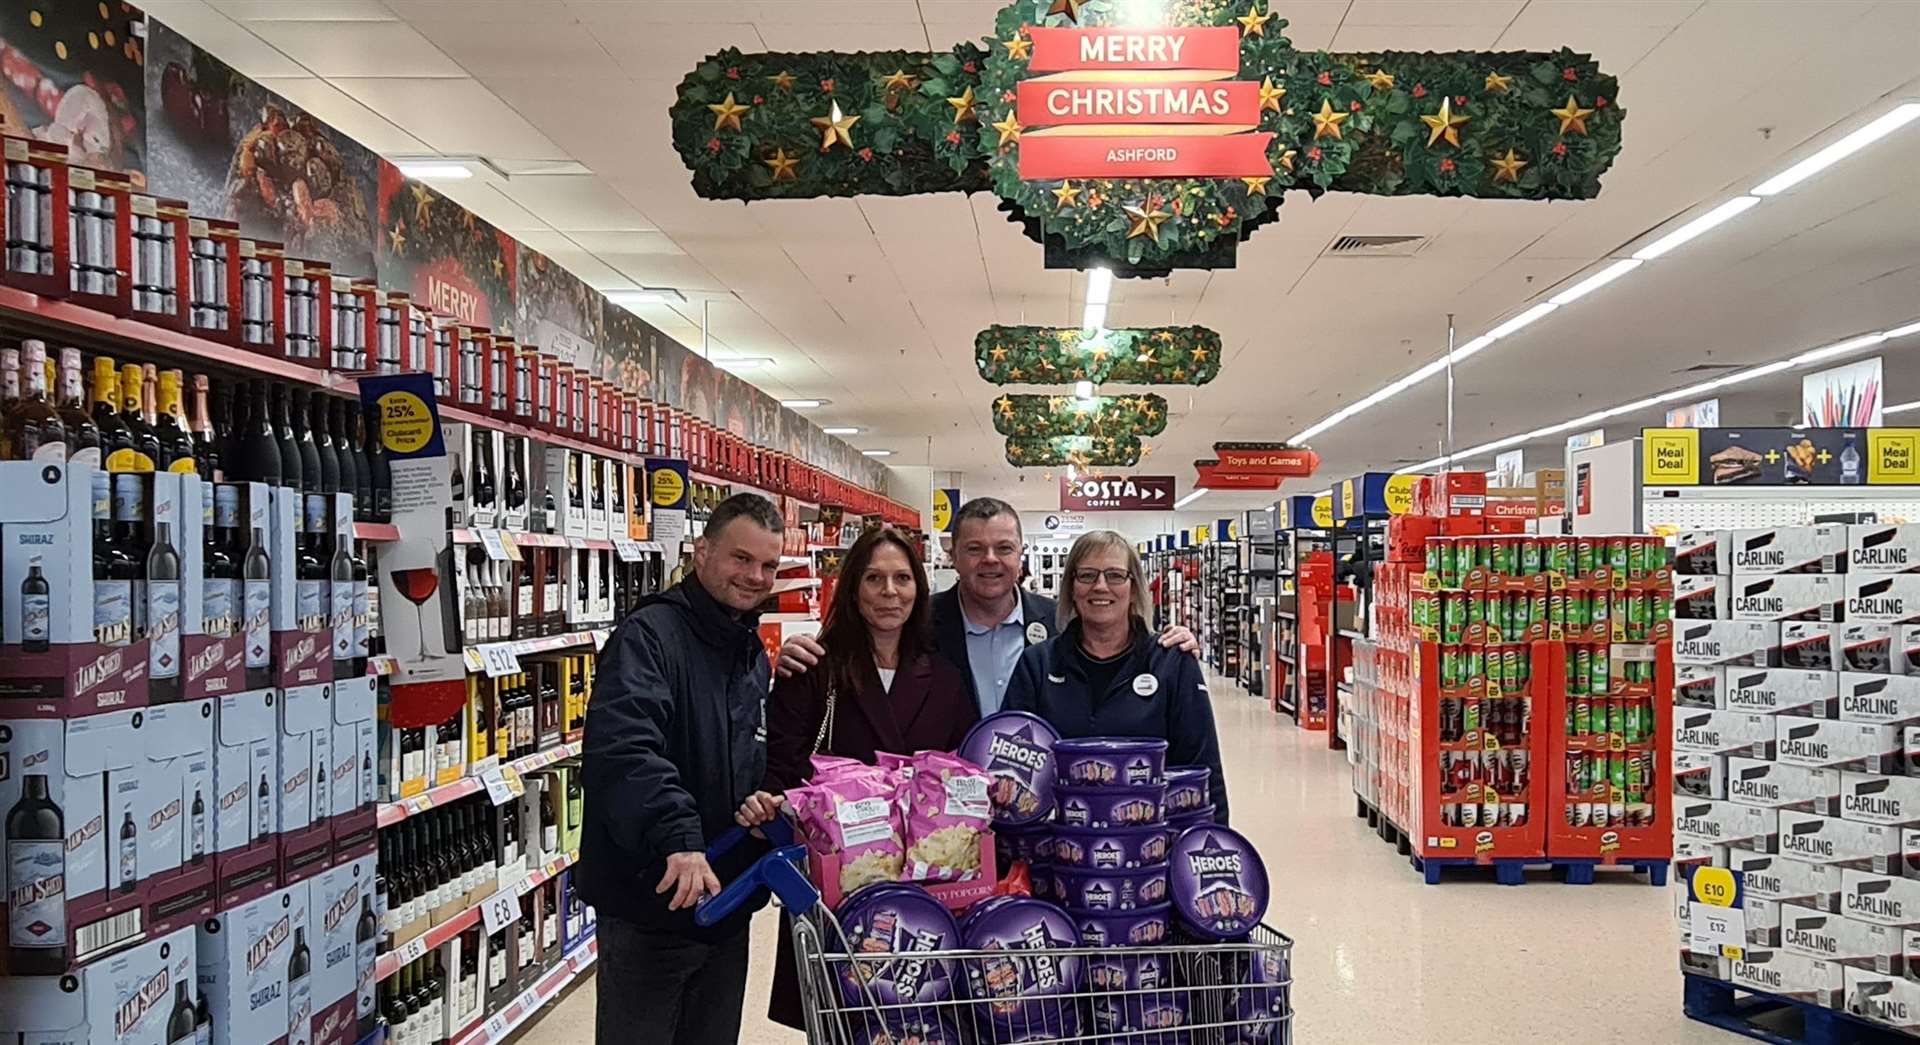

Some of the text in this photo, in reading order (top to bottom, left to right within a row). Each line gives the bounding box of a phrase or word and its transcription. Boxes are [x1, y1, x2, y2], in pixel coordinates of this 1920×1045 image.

[1080, 35, 1185, 62] MERRY
[1047, 88, 1230, 116] CHRISTMAS
[1106, 148, 1177, 163] ASHFORD
[429, 275, 477, 323] MERRY
[386, 404, 415, 418] 25%
[1226, 456, 1302, 466] Toys and Games
[1657, 447, 1684, 458] Meal
[1883, 447, 1909, 458] Meal
[1657, 458, 1684, 469] Deal
[1883, 458, 1909, 469] Deal
[1395, 496, 1411, 504] Pric
[19, 534, 55, 545] SHIRAZ
[1737, 550, 1784, 566] CARLING
[1853, 548, 1907, 565] CARLING
[1736, 597, 1783, 612] CARLING
[1849, 598, 1903, 614] CARLING
[1676, 641, 1720, 657] CARLING
[488, 650, 513, 672] £12
[75, 666, 97, 698] JAM
[97, 690, 126, 707] SHIRAZ
[1730, 688, 1776, 706] CARLING
[1844, 696, 1898, 715] CARLING
[1676, 729, 1720, 747] CARLING
[989, 735, 1047, 769] HEROES
[1780, 740, 1829, 759] CARLING
[1732, 780, 1779, 799] CARLING
[1845, 794, 1900, 816] CARLING
[1676, 818, 1721, 837] CARLING
[1783, 834, 1833, 856] CARLING
[1189, 854, 1241, 873] HEROES
[1704, 883, 1725, 897] £10
[1743, 873, 1781, 893] ARLING
[950, 886, 992, 900] POPCORN
[494, 898, 511, 926] £8
[1847, 893, 1902, 918] CARLING
[1710, 922, 1726, 933] £12
[1785, 928, 1837, 953] CARLING
[247, 935, 268, 976] JAM
[326, 942, 351, 969] SHIRAZ
[1023, 924, 1058, 989] HEOES
[1735, 961, 1782, 987] CARLING
[115, 965, 170, 1040] JAM SHED
[251, 980, 282, 1011] SHIRAZ
